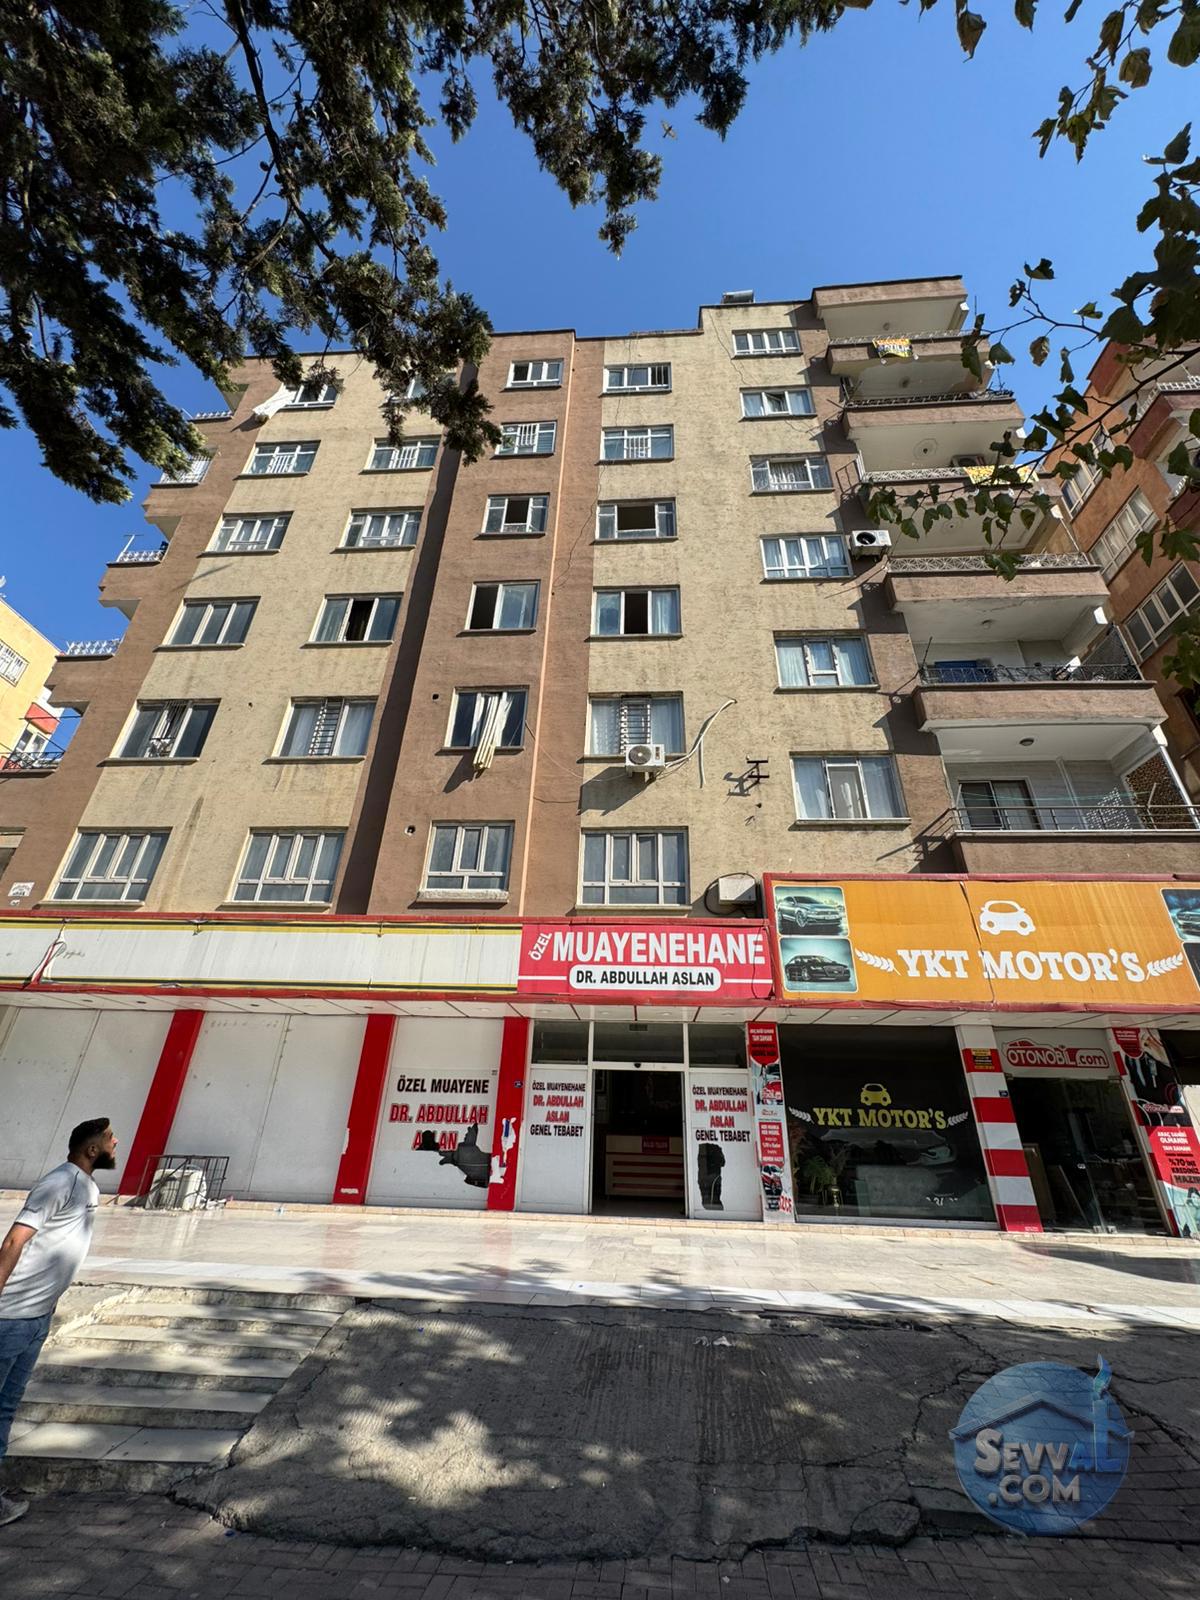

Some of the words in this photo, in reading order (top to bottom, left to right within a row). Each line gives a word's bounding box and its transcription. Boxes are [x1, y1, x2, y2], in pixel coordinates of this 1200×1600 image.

[528, 932, 552, 961] ÖZEL
[552, 932, 765, 964] MUAYENEHANE
[897, 949, 969, 978] YKT
[982, 949, 1145, 983] MOTOR'S
[576, 970, 597, 984] DR.
[600, 971, 669, 985] ABDULLAH
[672, 971, 715, 986] ASLAN
[397, 1075, 427, 1092] ÖZEL
[431, 1079, 490, 1094] MUAYENE
[532, 1080, 546, 1091] ÖZEL
[547, 1083, 586, 1092] MUAYENEHANE
[692, 1085, 706, 1095] ÖZEL
[707, 1087, 748, 1096] MUAYENEHANE
[533, 1095, 545, 1106] DR.
[546, 1095, 584, 1108] ABDULLAH
[695, 1100, 708, 1111] DR.
[709, 1100, 748, 1112] ABDULLAH
[389, 1104, 413, 1123] DR.
[415, 1104, 489, 1124] ABDULLAH
[545, 1111, 570, 1123] ASLAN
[813, 1108, 852, 1126] YKT
[857, 1108, 947, 1129] MOTOR'S
[710, 1116, 735, 1128] ASLAN
[530, 1124, 551, 1136] GENEL
[553, 1125, 584, 1137] TEBABET
[695, 1130, 718, 1141] GENEL
[719, 1130, 751, 1142] TEBABET
[412, 1130, 458, 1151] AAN
